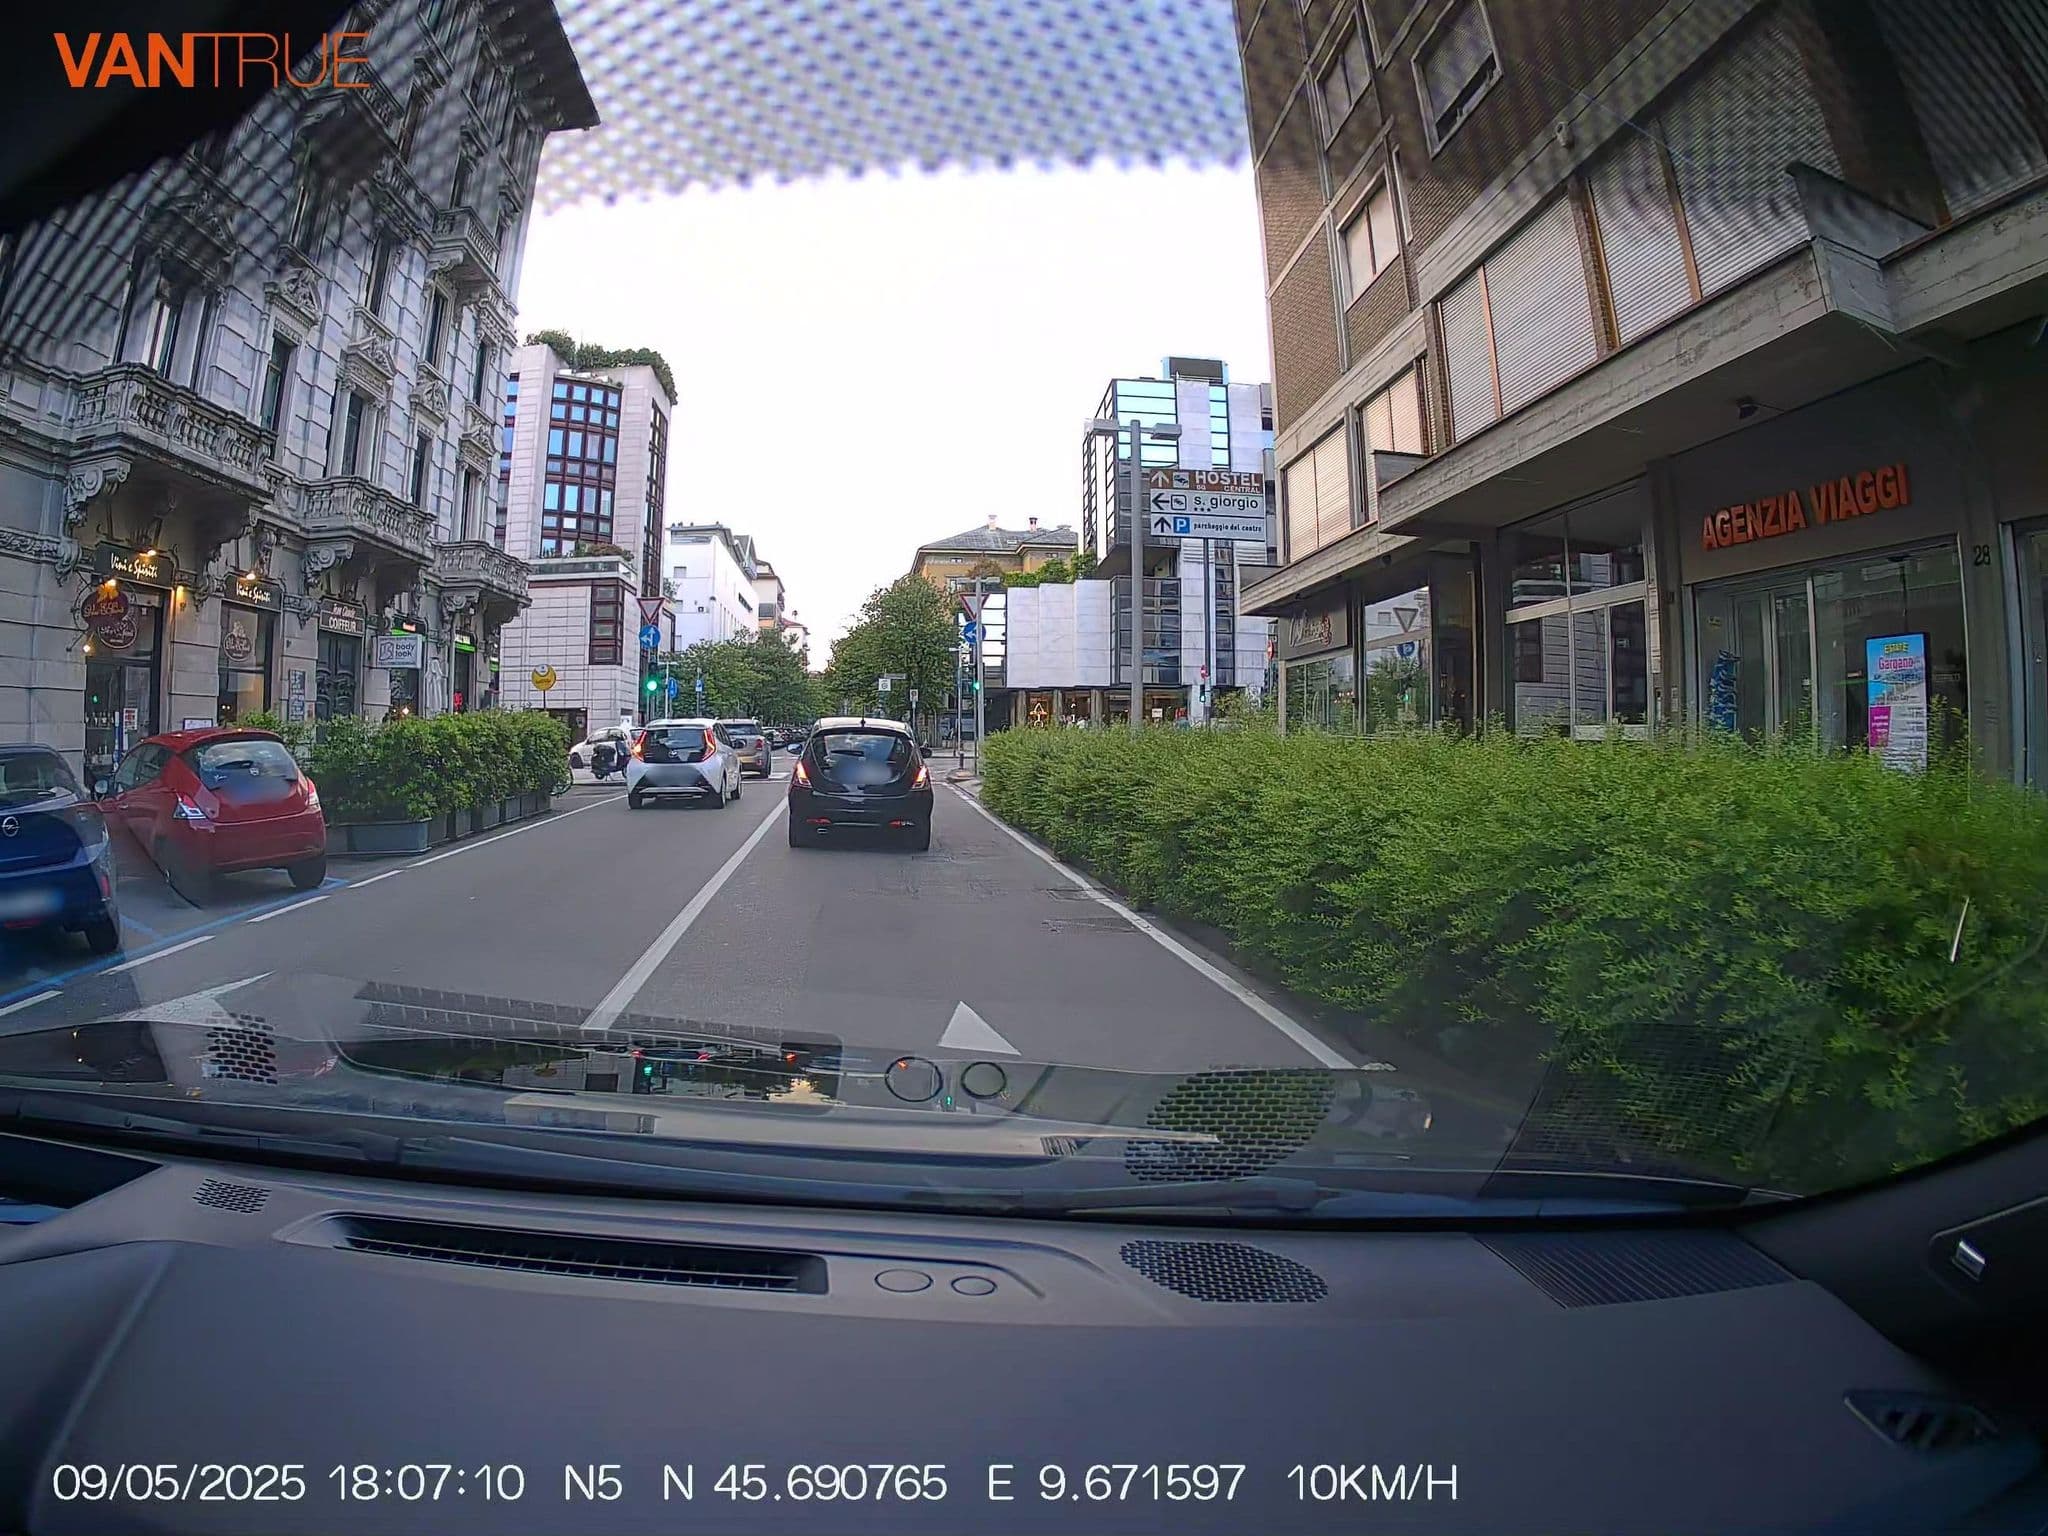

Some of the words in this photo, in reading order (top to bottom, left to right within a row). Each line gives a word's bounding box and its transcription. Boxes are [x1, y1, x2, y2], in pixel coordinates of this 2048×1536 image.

[1195, 471, 1260, 487] HOSTEL
[1223, 485, 1260, 494] CENTRAL
[1210, 496, 1258, 510] giorgio
[1702, 490, 1807, 550] AGENZIA
[1809, 463, 1911, 524] VIAGGI
[110, 552, 127, 571] Vini
[1973, 544, 1991, 566] 28
[236, 581, 249, 597] Vini
[328, 617, 357, 633] COIFFEUR
[395, 642, 416, 651] body
